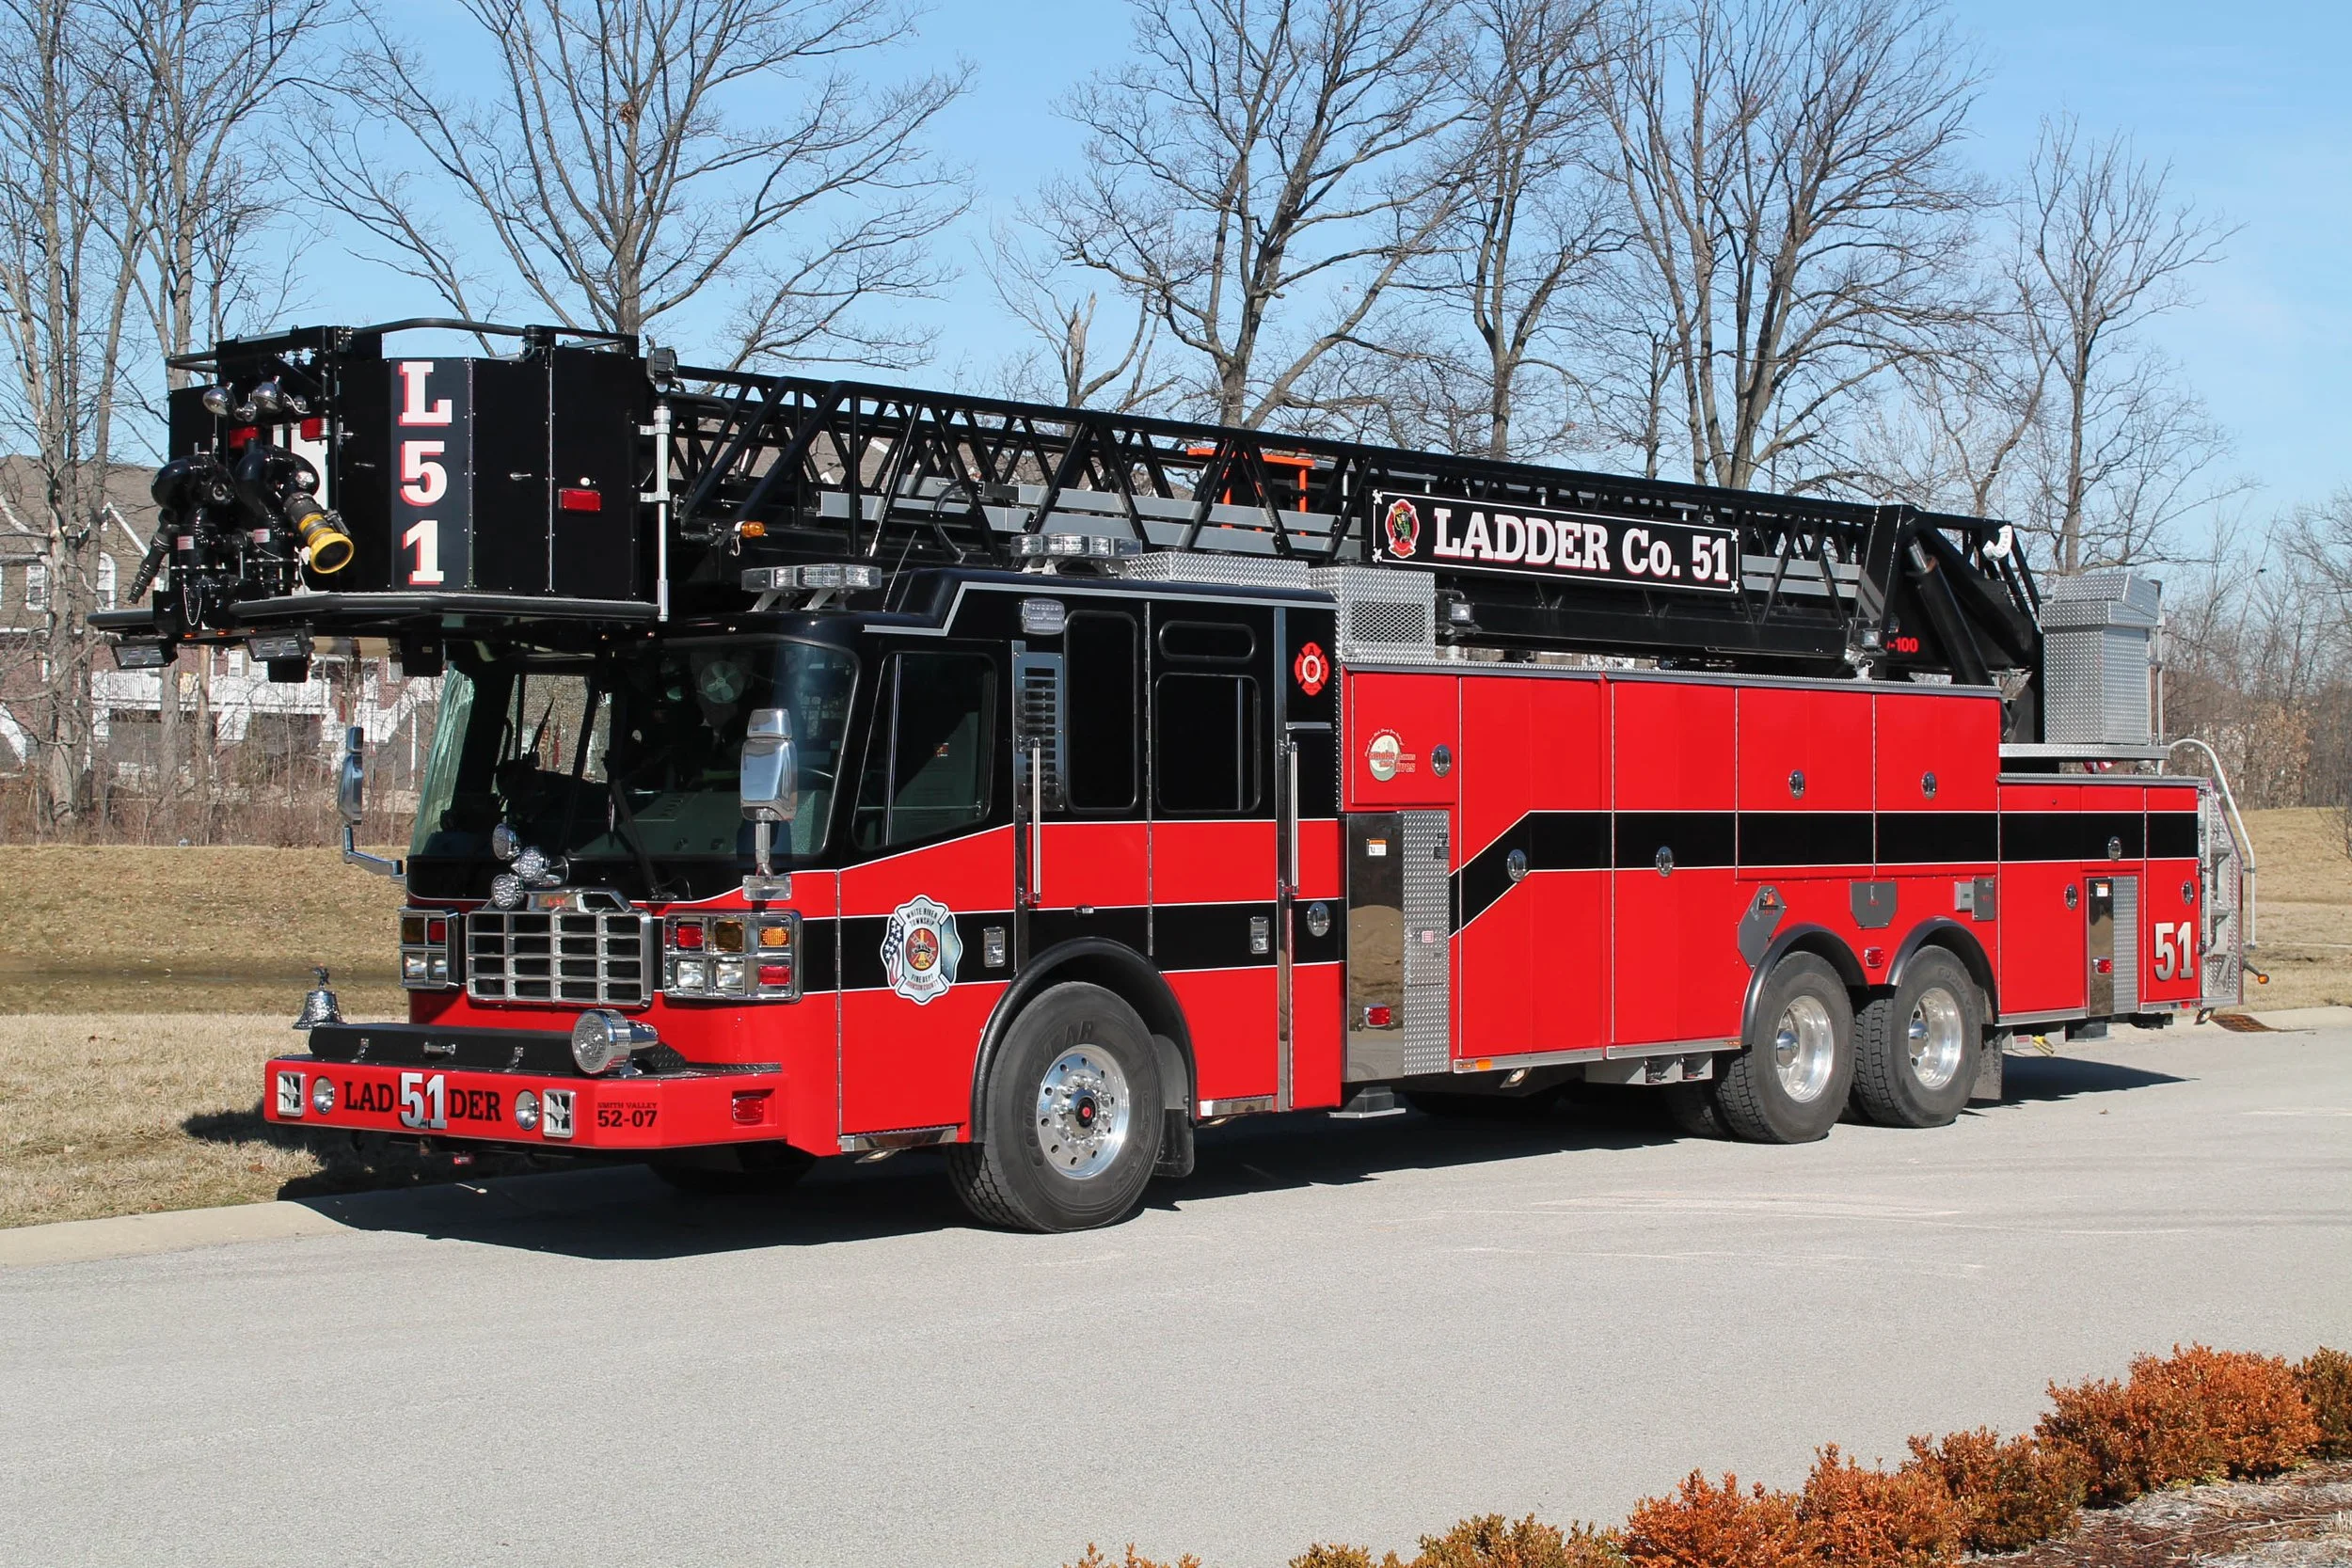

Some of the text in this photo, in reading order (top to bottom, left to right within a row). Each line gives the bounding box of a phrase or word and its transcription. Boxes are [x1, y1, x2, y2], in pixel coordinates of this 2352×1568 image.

[399, 361, 453, 585] L51
[1434, 508, 1729, 582] LADDER Co. 51
[1886, 637, 1919, 653] -100
[2154, 921, 2194, 981] 51
[343, 1071, 502, 1130] LAD 51 DER
[597, 1109, 658, 1128] 52-07
